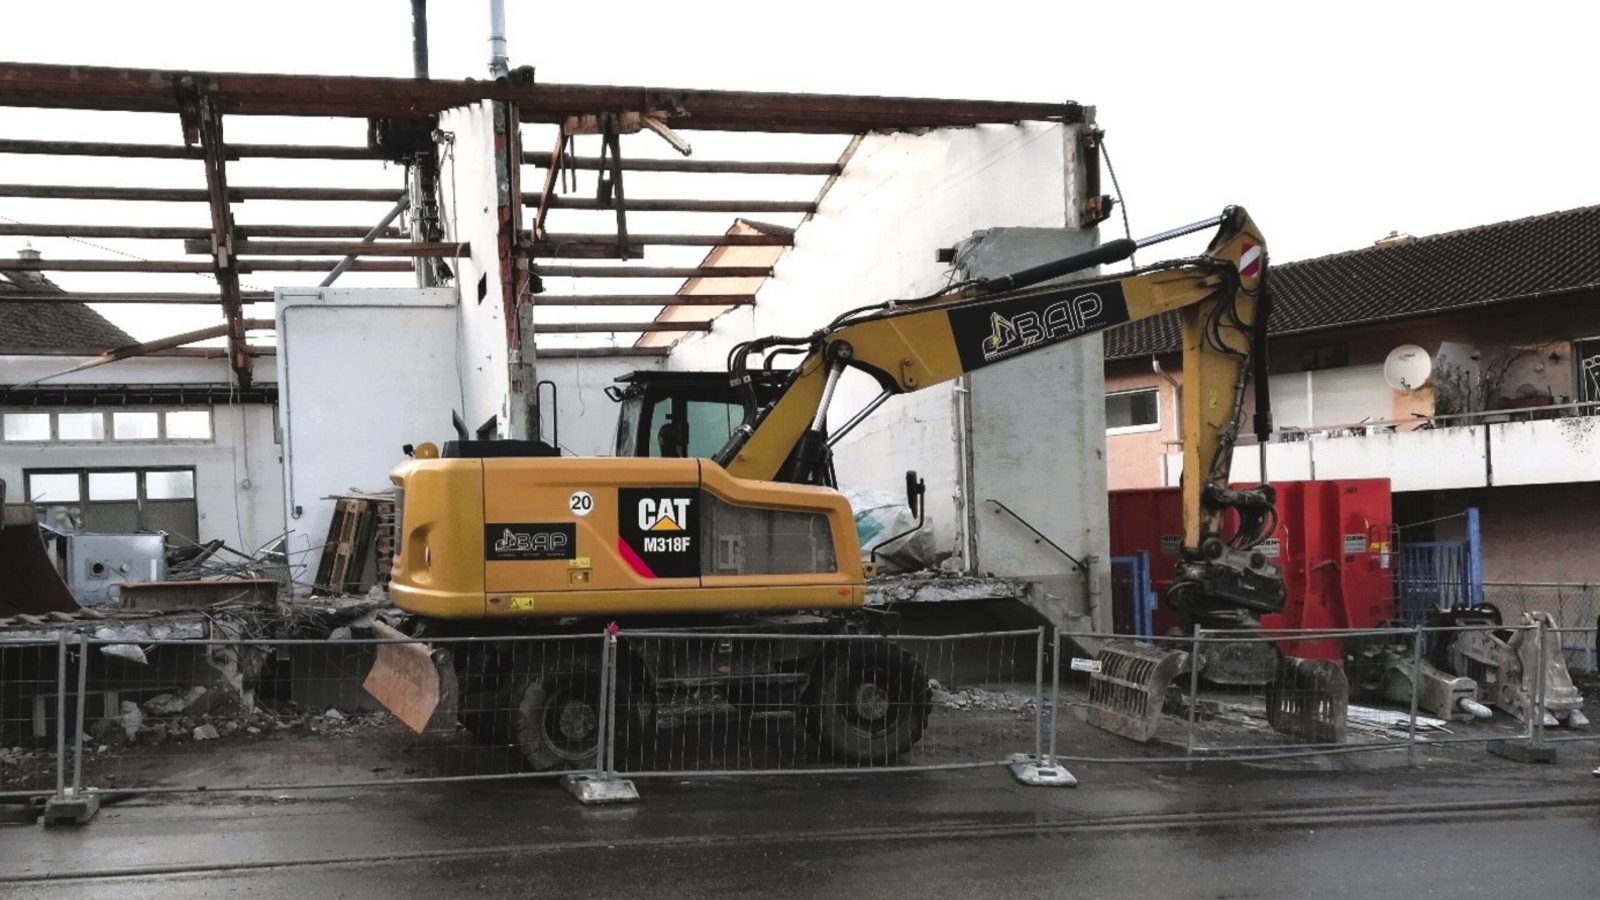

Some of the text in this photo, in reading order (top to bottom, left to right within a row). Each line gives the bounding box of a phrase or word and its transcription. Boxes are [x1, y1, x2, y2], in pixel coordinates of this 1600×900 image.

[1011, 292, 1103, 343] BAP
[572, 495, 592, 510] 20
[638, 498, 691, 531] CAT
[515, 532, 568, 551] BAP
[644, 537, 691, 552] M318F
